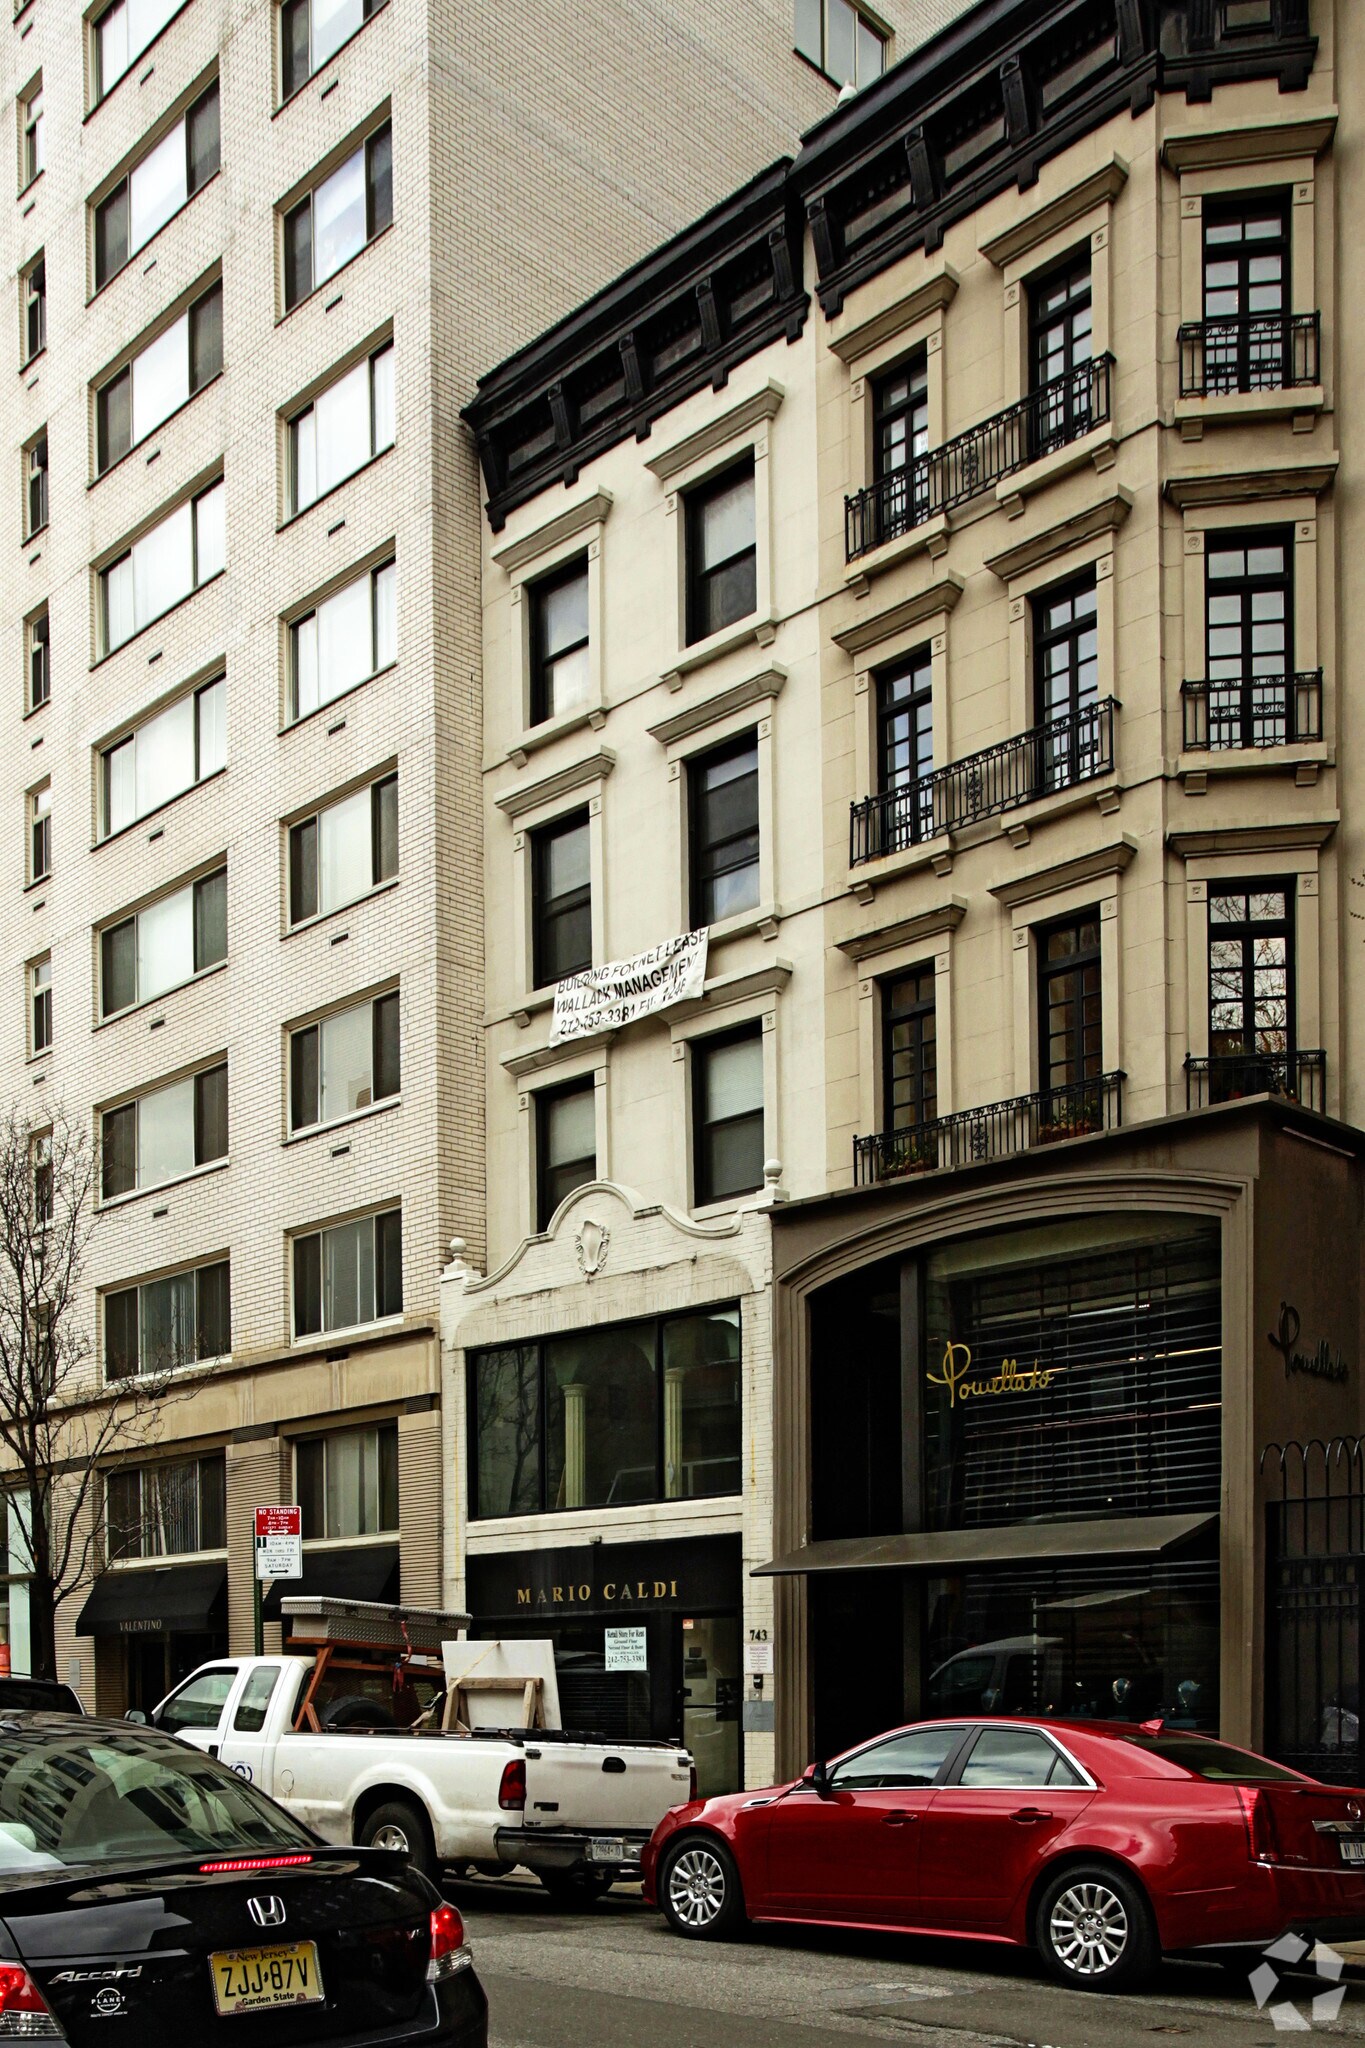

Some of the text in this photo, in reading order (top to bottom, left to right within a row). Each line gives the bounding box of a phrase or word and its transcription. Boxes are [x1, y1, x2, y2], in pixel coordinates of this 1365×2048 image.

[557, 966, 609, 994] BUILDING
[666, 929, 706, 958] LEASE
[556, 950, 699, 1014] WALLACK MANAGEMENT
[517, 1580, 678, 1604] MARIO CALDI
[119, 1618, 162, 1632] VALENTINO
[749, 1629, 768, 1641] 743
[237, 1948, 290, 1963] New Jersey
[47, 1965, 143, 1985] Accord
[91, 1995, 126, 2005] PLANET
[242, 1991, 295, 2006] Garden State
